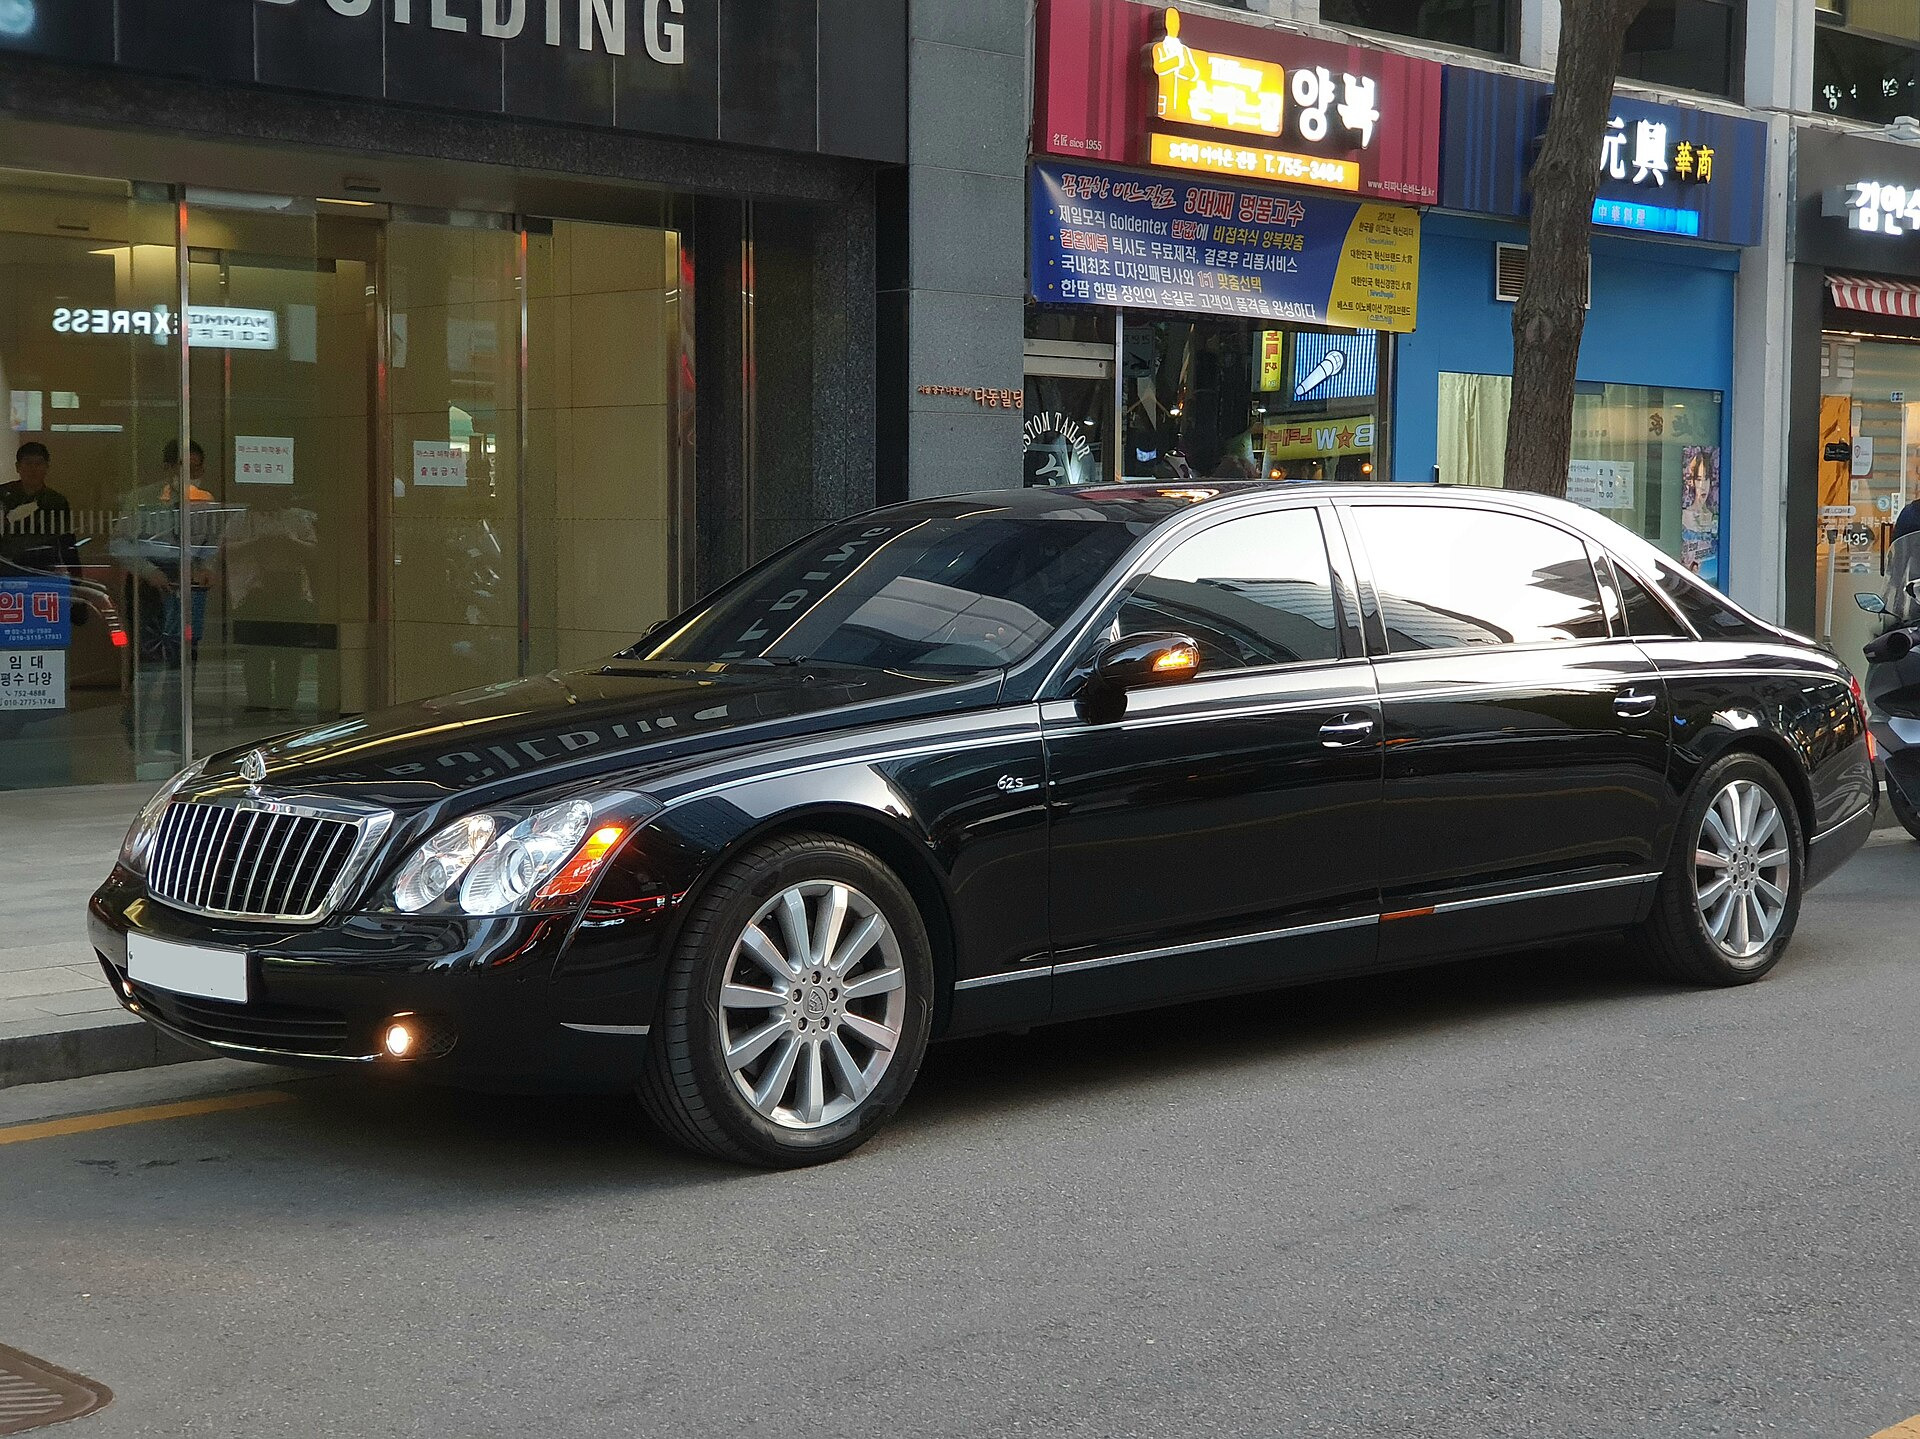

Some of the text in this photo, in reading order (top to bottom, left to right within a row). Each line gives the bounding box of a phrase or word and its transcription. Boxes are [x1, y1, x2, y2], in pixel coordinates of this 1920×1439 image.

[256, 0, 685, 65] DING
[1291, 66, 1380, 150] 양복
[1085, 139, 1102, 151] 1955
[1062, 173, 1305, 228] 꼼꼼한 바느질로 3대째 명품고수
[1059, 203, 1305, 252] 제일모직 Goldentex 반값에 비접착식 양복맞춤
[1059, 228, 1298, 273] 결혼예복 턱시도 무료제작, 결혼후 리폼서비스
[1350, 248, 1373, 261] 대한민국
[1061, 254, 1111, 276] 국내최초
[1115, 260, 1195, 286] 디자인패턴사와
[1217, 273, 1262, 293] 맞춤선택
[1351, 275, 1373, 288] 대한민국
[1061, 279, 1316, 320] 한땀 한땀 장인의 손길로 고객의 품격을 완성하다
[973, 386, 1024, 409] 다동빌딩
[1023, 411, 1091, 461] STOM TAILOR
